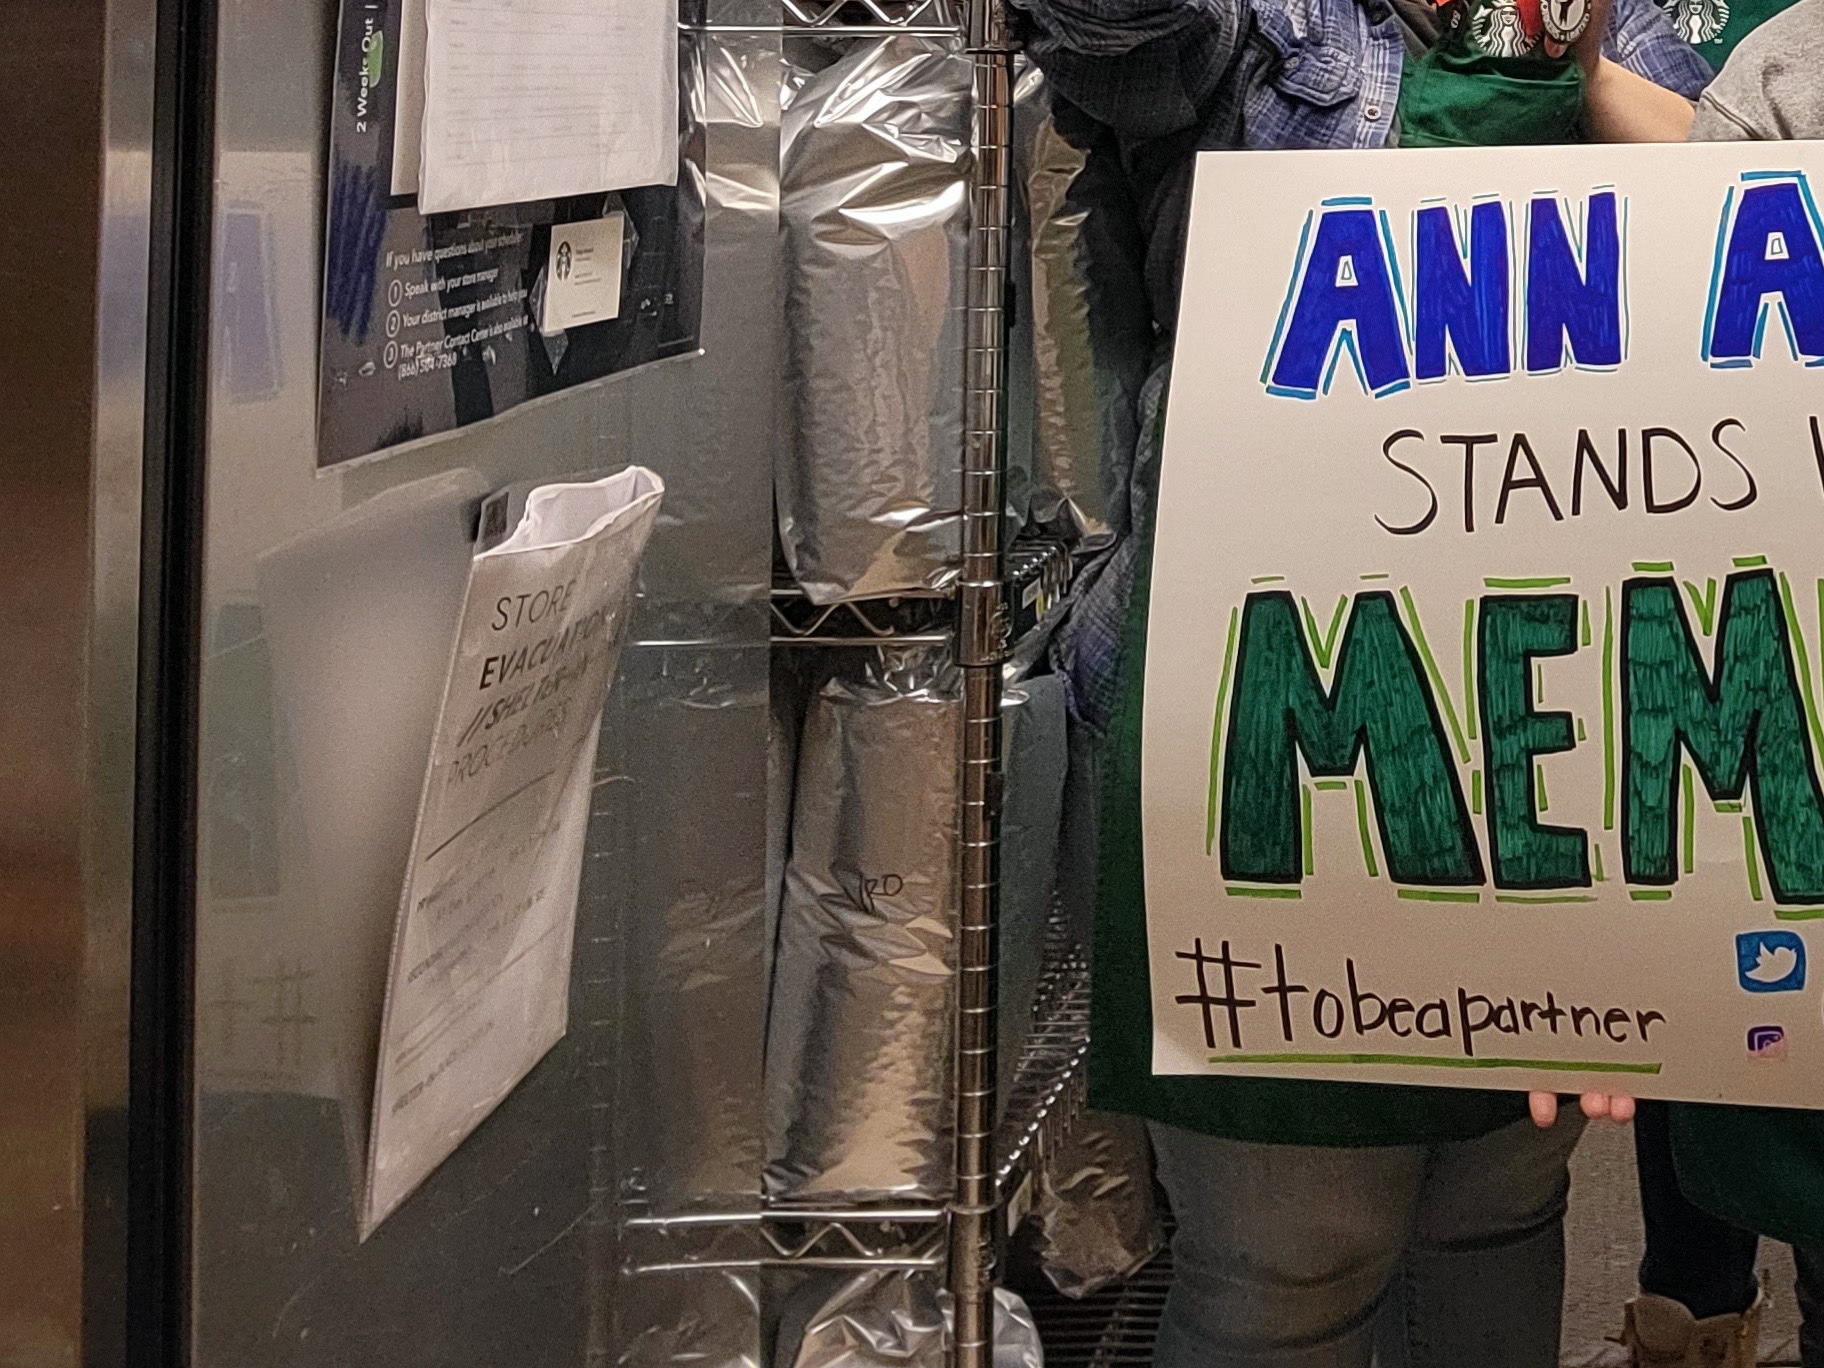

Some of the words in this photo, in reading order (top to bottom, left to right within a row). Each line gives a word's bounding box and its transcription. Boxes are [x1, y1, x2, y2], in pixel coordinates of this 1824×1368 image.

[411, 247, 433, 264] have
[404, 279, 431, 299] Speak
[1262, 186, 1626, 398] ANN
[403, 311, 422, 328] Your
[422, 306, 449, 325] district
[448, 300, 477, 321] manager
[400, 342, 416, 359] The
[415, 336, 444, 359] Partner
[444, 331, 471, 350] Contact
[1374, 418, 1758, 535] STANDS
[492, 579, 577, 631] STORE
[1175, 938, 1667, 1057] #tobeapartner
